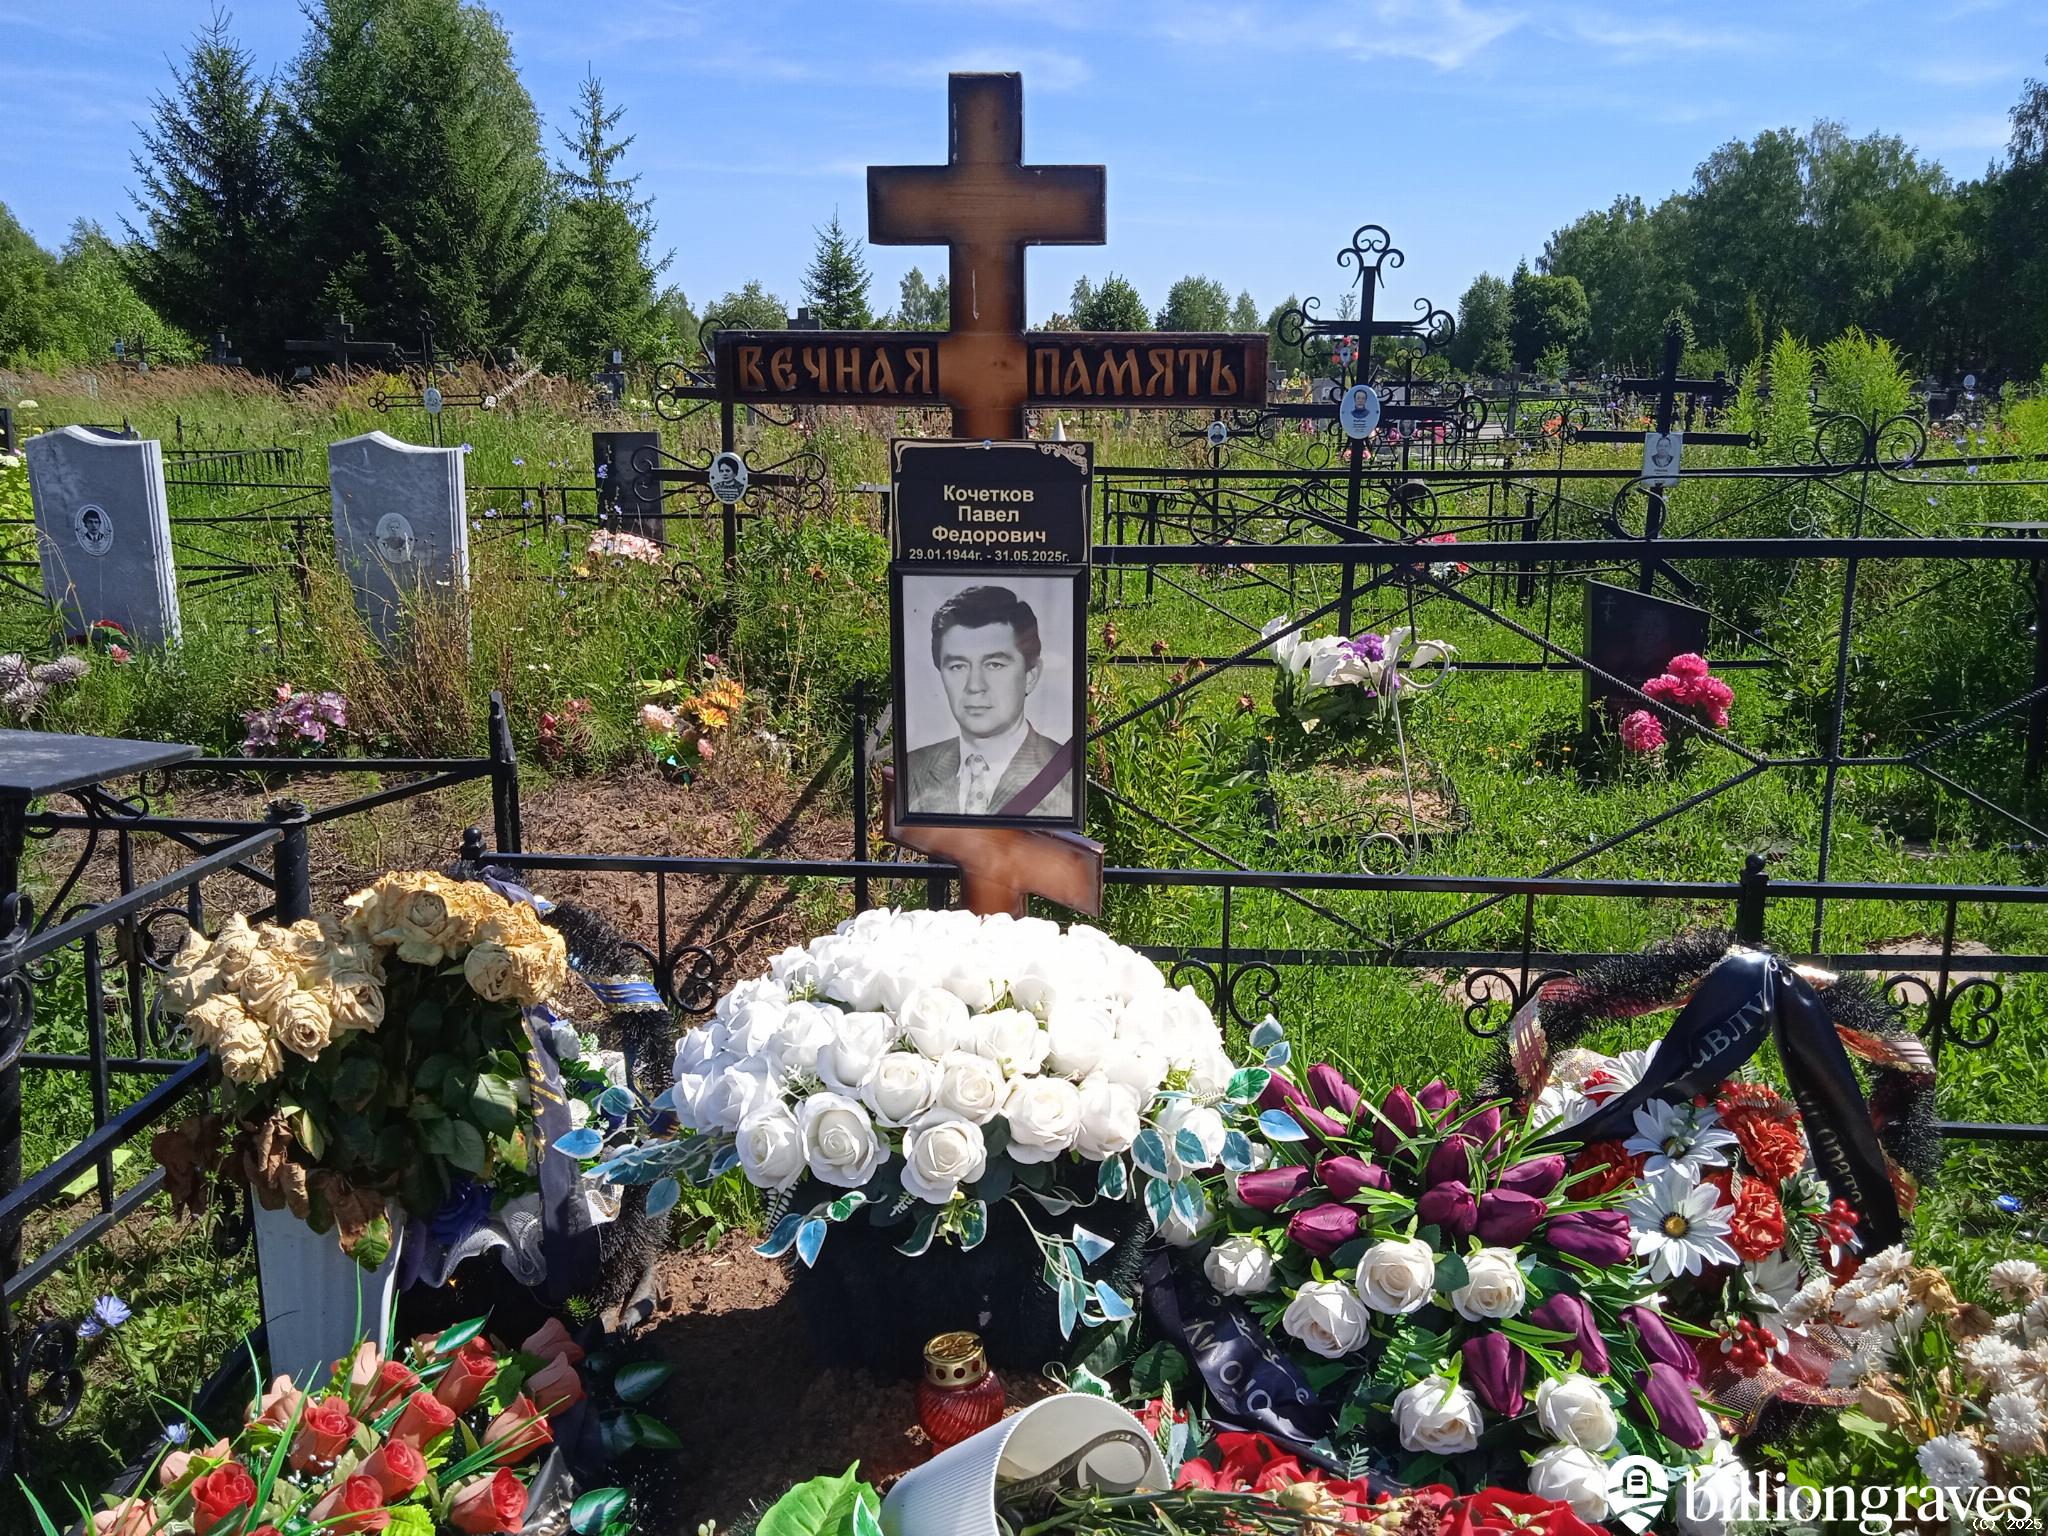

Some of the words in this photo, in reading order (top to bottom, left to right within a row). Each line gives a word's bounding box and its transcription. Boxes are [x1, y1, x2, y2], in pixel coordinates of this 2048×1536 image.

[737, 345, 931, 394] ВЕЧНАЯ
[1034, 346, 1239, 396] ПАМЯТЬ
[943, 484, 1034, 503] Кочетков
[958, 505, 1019, 523] Павел
[931, 525, 1047, 546] Федорович
[908, 548, 983, 561] 29.01.1944г.
[994, 549, 1070, 563] 31.05.2025г.
